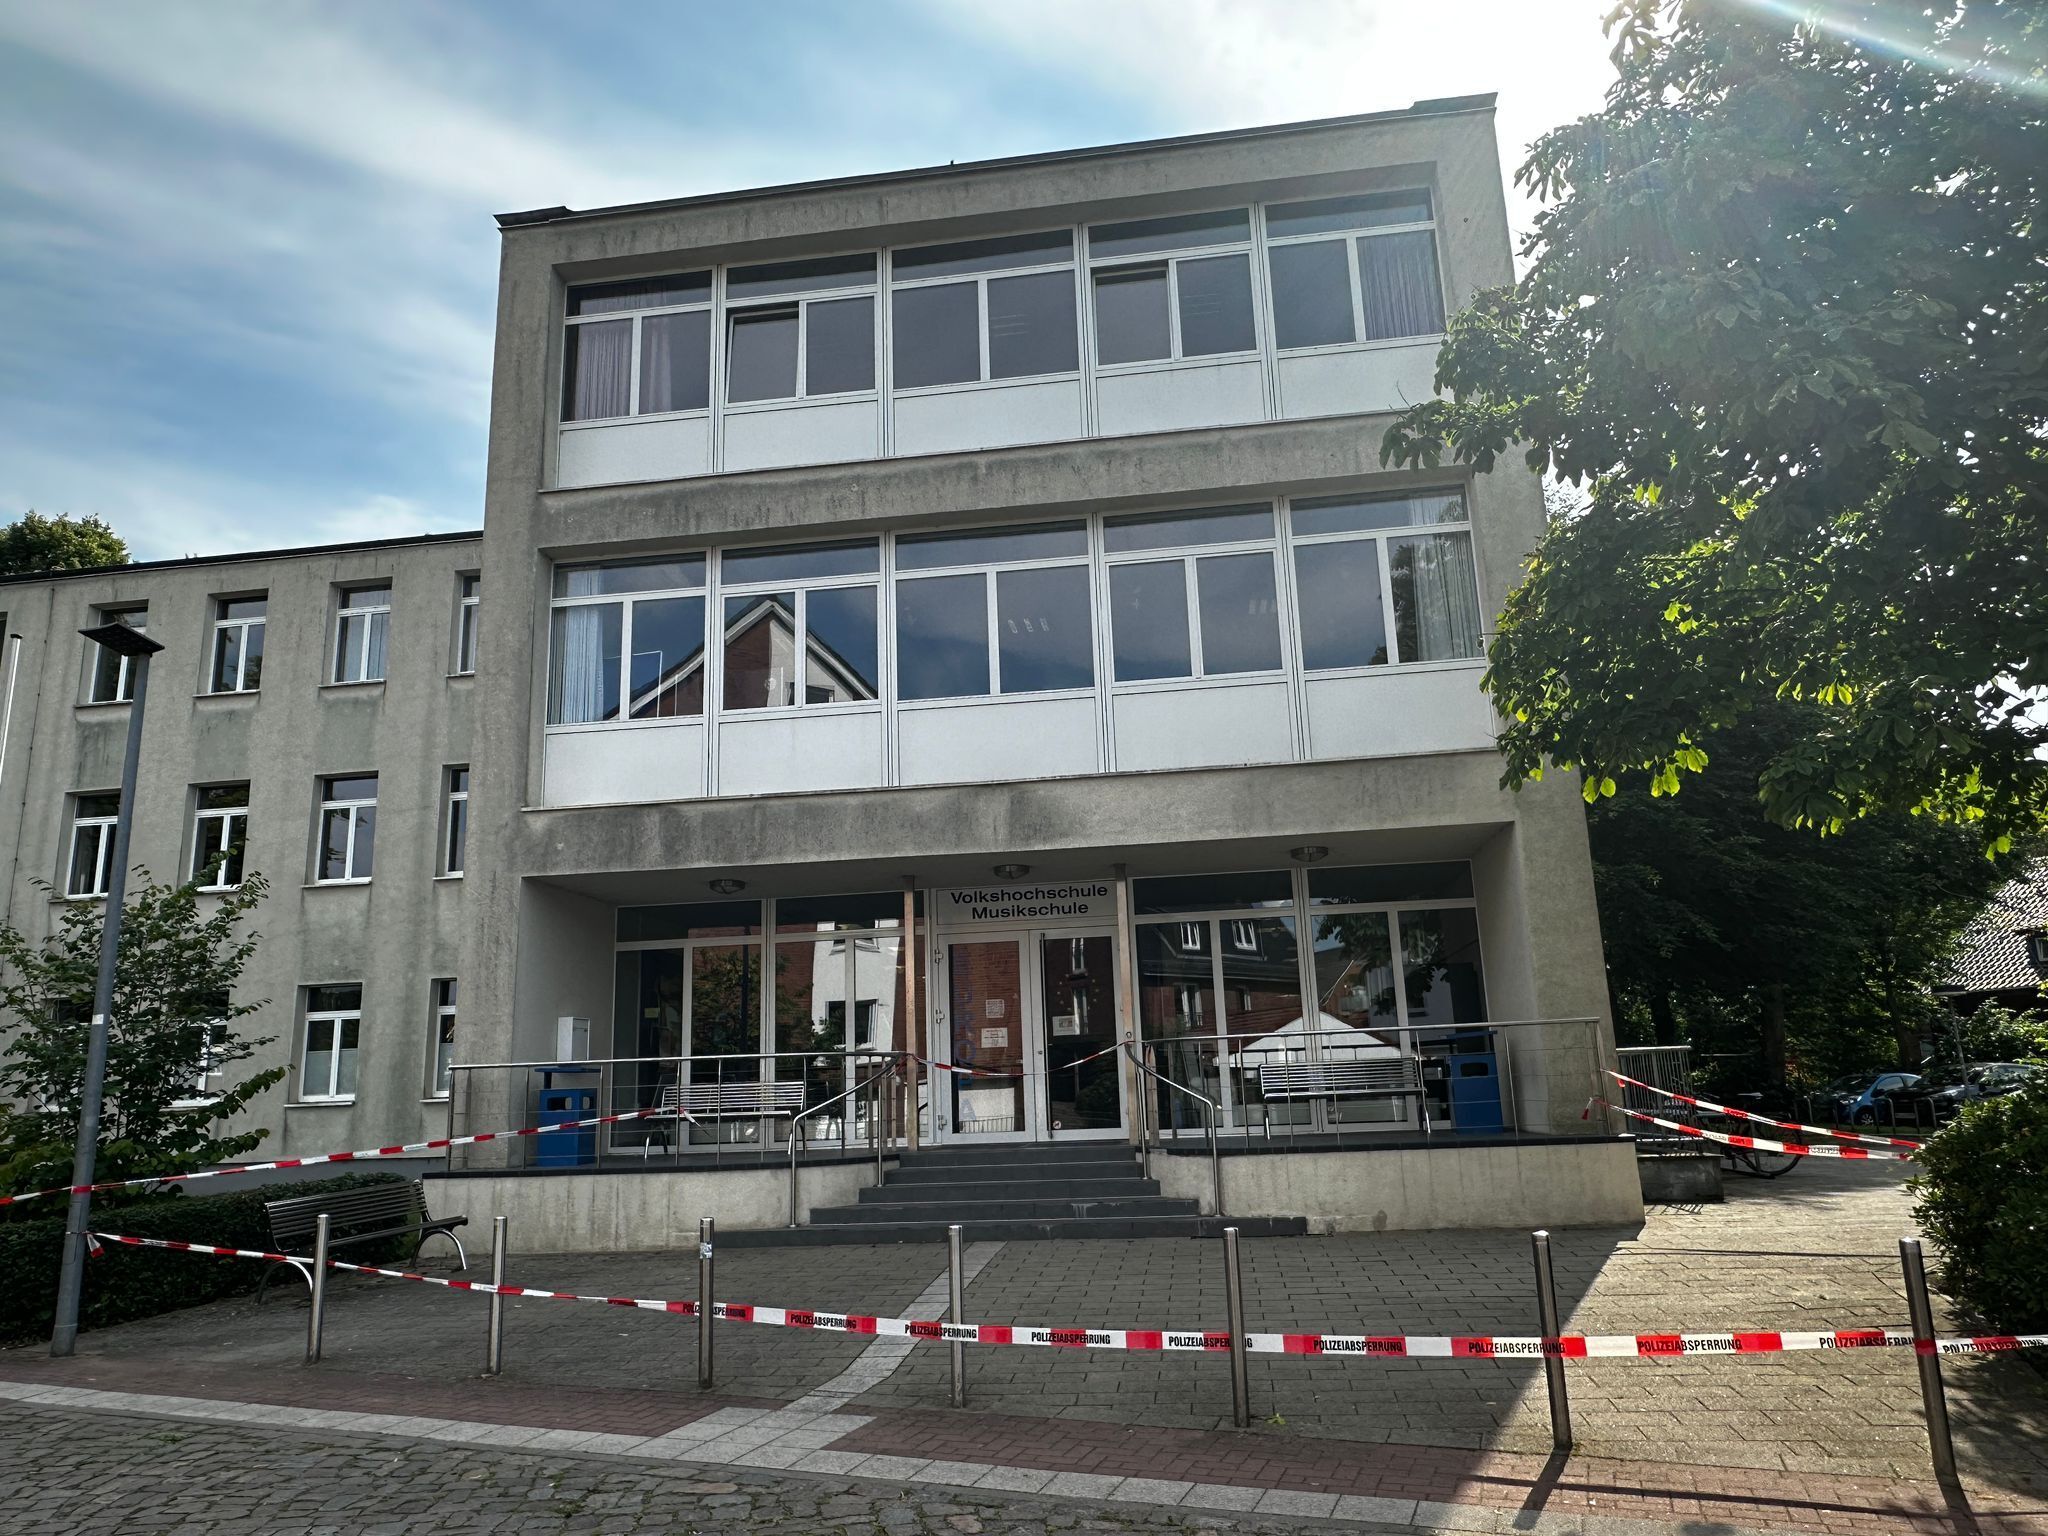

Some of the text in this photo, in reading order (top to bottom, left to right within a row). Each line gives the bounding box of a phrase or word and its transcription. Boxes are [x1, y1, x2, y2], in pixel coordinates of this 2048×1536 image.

[951, 884, 1108, 905] Volkshochschule
[972, 902, 1089, 920] Musikschule
[904, 1324, 977, 1339] POLIZEIABSPERRUNG
[1031, 1331, 1111, 1345] POLIZEIABSPERRUNG
[1168, 1336, 1253, 1348] POLIZEIABSPERG
[1313, 1340, 1403, 1352] POLIZEIABSPERRUNG
[1468, 1342, 1566, 1354] POLIZEIABSPERRUNG
[1637, 1339, 1743, 1353] POLIZEIABSPERRUNG
